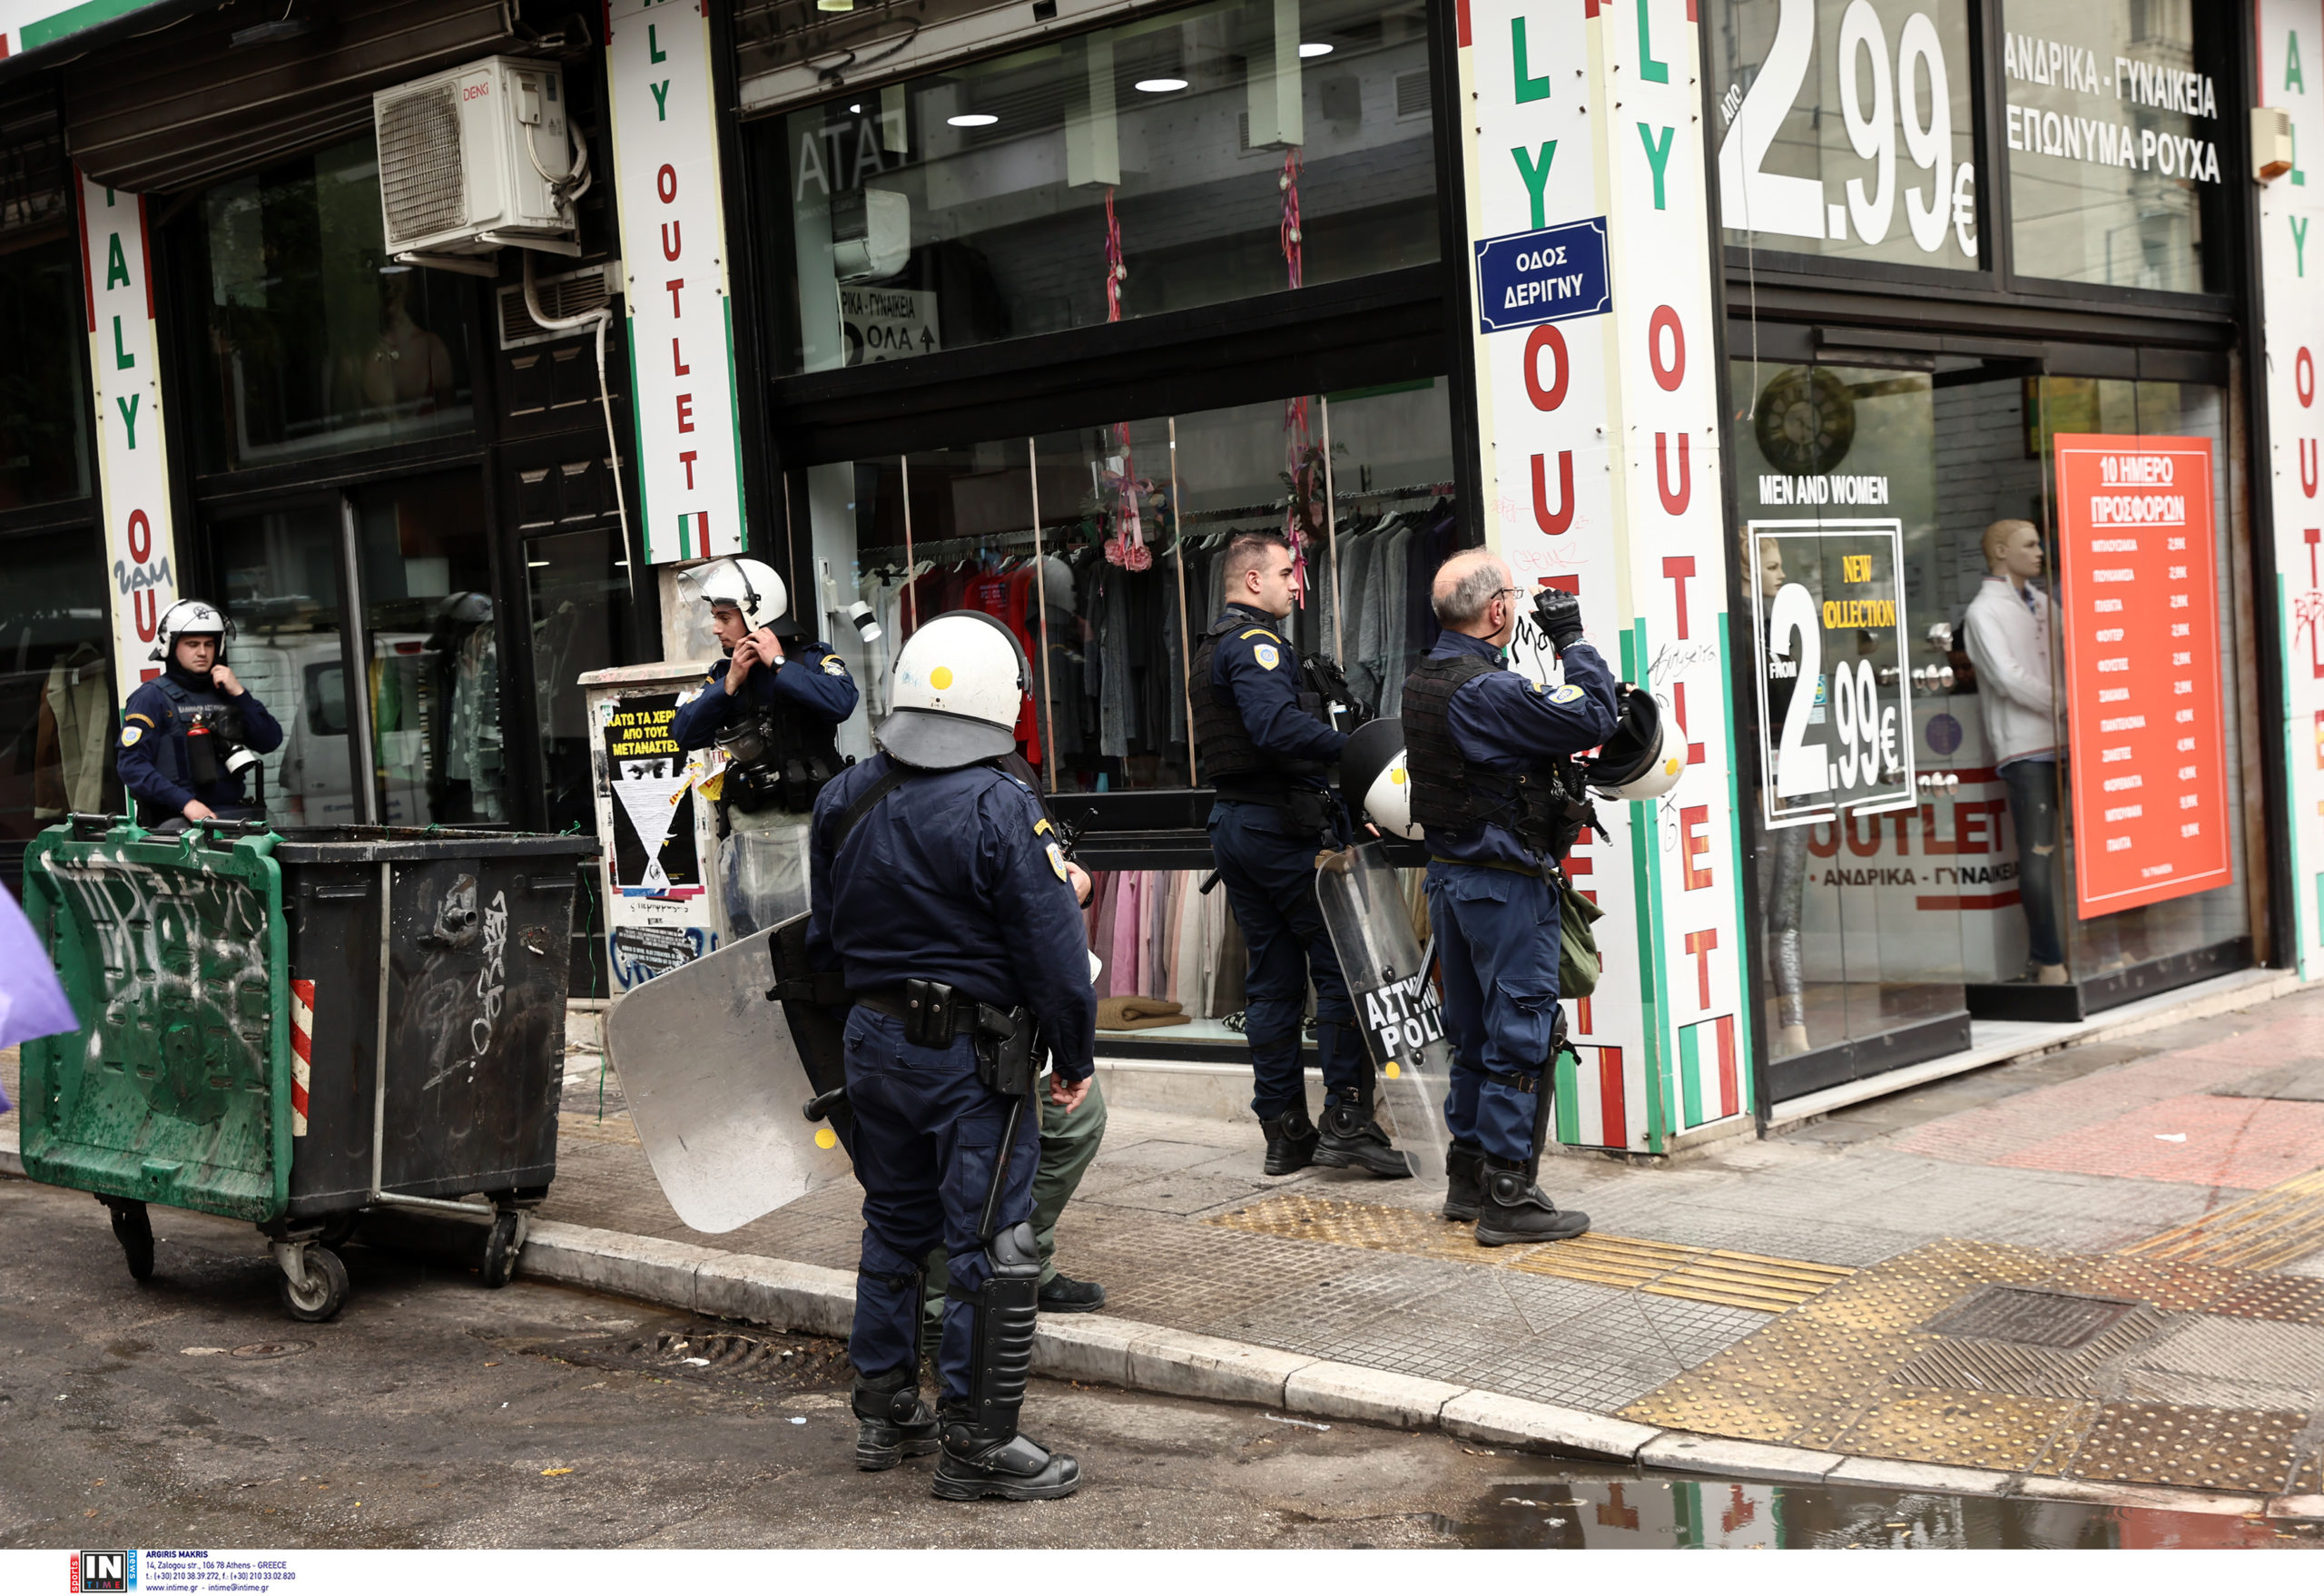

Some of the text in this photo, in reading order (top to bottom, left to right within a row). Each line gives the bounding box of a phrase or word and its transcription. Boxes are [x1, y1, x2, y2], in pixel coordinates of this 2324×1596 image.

[2004, 32, 2100, 95] ΑΝΔΡΙΚΑ
[2114, 56, 2217, 120] ΓΥΝΑΙΚΕΙΑ
[1718, 0, 1977, 257] 2.99€
[2006, 103, 2221, 184] ΕΠΩΝΥΜΑ ΡΟΥΧΑ
[644, 0, 698, 490] LY OUTLET
[1516, 245, 1568, 272] ΟΔΟΣ
[838, 291, 863, 315] ΡΙΚΑ
[869, 293, 915, 319] ΓΥΝΑΙΚΕΙΑ
[1503, 273, 1583, 310] ΔΕΡΙΓΝΥ
[106, 188, 141, 450] ALY
[867, 324, 913, 350] ΟΛΑ
[2100, 457, 2173, 482] 10 ΗΜΕΡΟ
[1758, 475, 1888, 505] MEN AND WOMEN
[2091, 496, 2185, 522] ΠΡΟΣΦΟΡΩΝ
[1842, 555, 1872, 583] NEW
[1823, 599, 1896, 629] COLLECTION
[1649, 305, 1718, 1010] OUTLET
[1770, 661, 1797, 679] FROM
[1769, 583, 1898, 797] 2.99€
[623, 725, 668, 740] ΑΠΟ ΤΟΥΣ
[636, 712, 651, 725] ΤΑ
[613, 739, 679, 756] ΜΕΤΑΝΑΣΤΕΣ
[1807, 797, 2005, 858] OUTLET
[1824, 868, 1916, 887] ΑΝΔΡΙΚΑ
